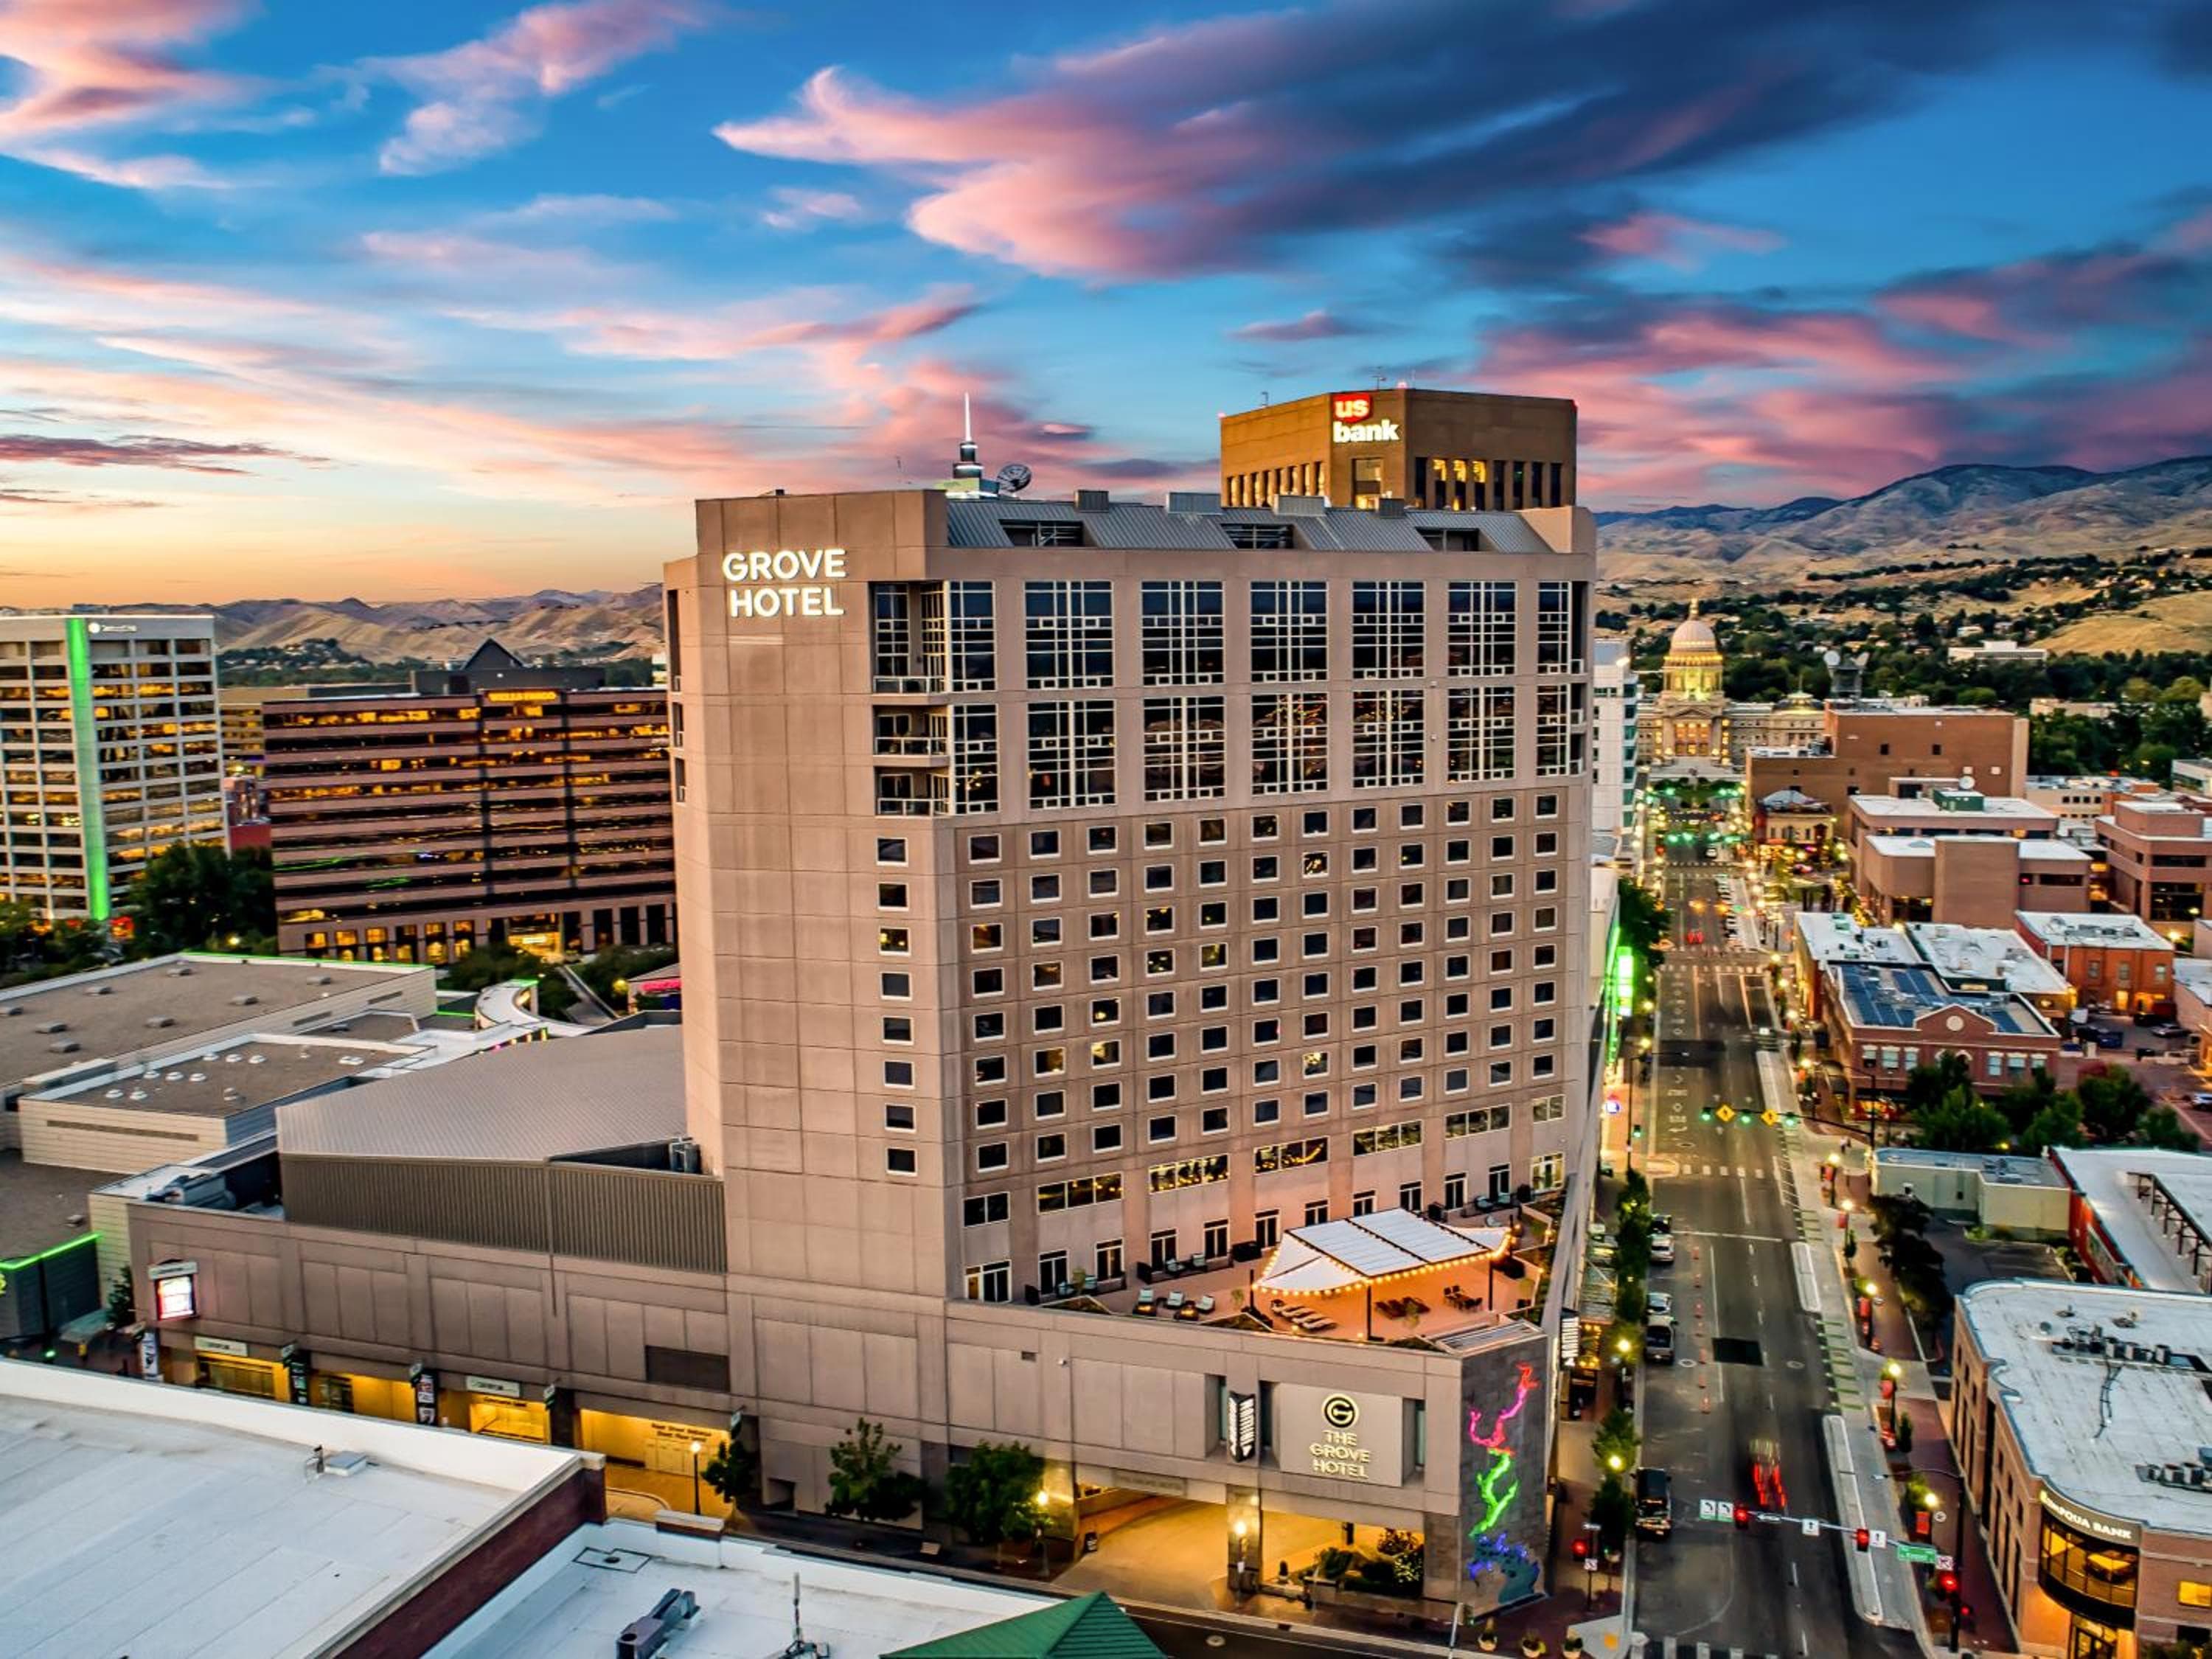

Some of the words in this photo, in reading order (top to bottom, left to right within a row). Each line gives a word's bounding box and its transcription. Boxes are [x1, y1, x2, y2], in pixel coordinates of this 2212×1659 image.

[1335, 399, 1369, 419] us
[1333, 419, 1399, 443] bank
[723, 548, 847, 582] GROVE
[728, 586, 845, 618] HOTEL
[1322, 1430, 1357, 1447] THE
[1310, 1443, 1371, 1463] GROVE
[1312, 1459, 1369, 1479] HOTEL
[2092, 1522, 2132, 1540] BANK
